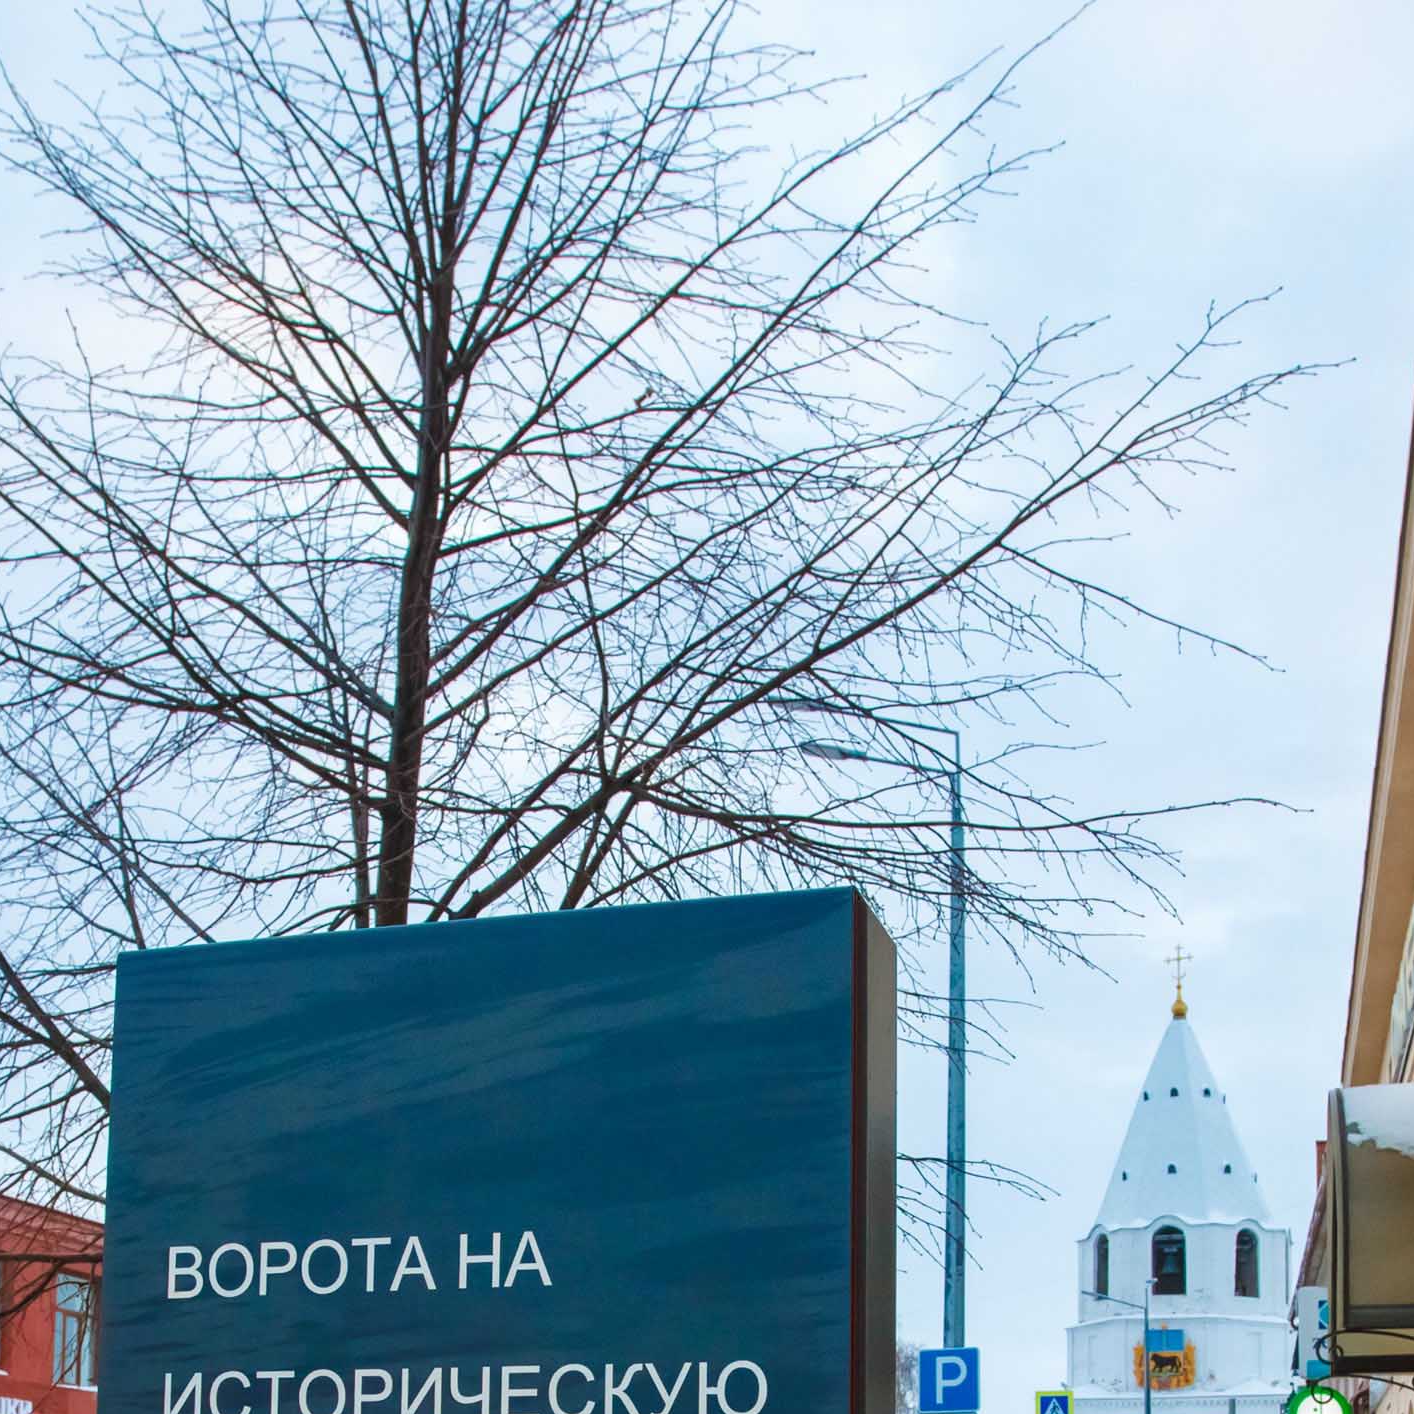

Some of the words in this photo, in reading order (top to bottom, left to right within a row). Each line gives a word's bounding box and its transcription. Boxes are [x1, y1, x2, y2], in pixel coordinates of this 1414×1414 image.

[167, 1235, 437, 1300] ВОРОТА
[458, 1230, 553, 1290] НА
[936, 1356, 967, 1404] P
